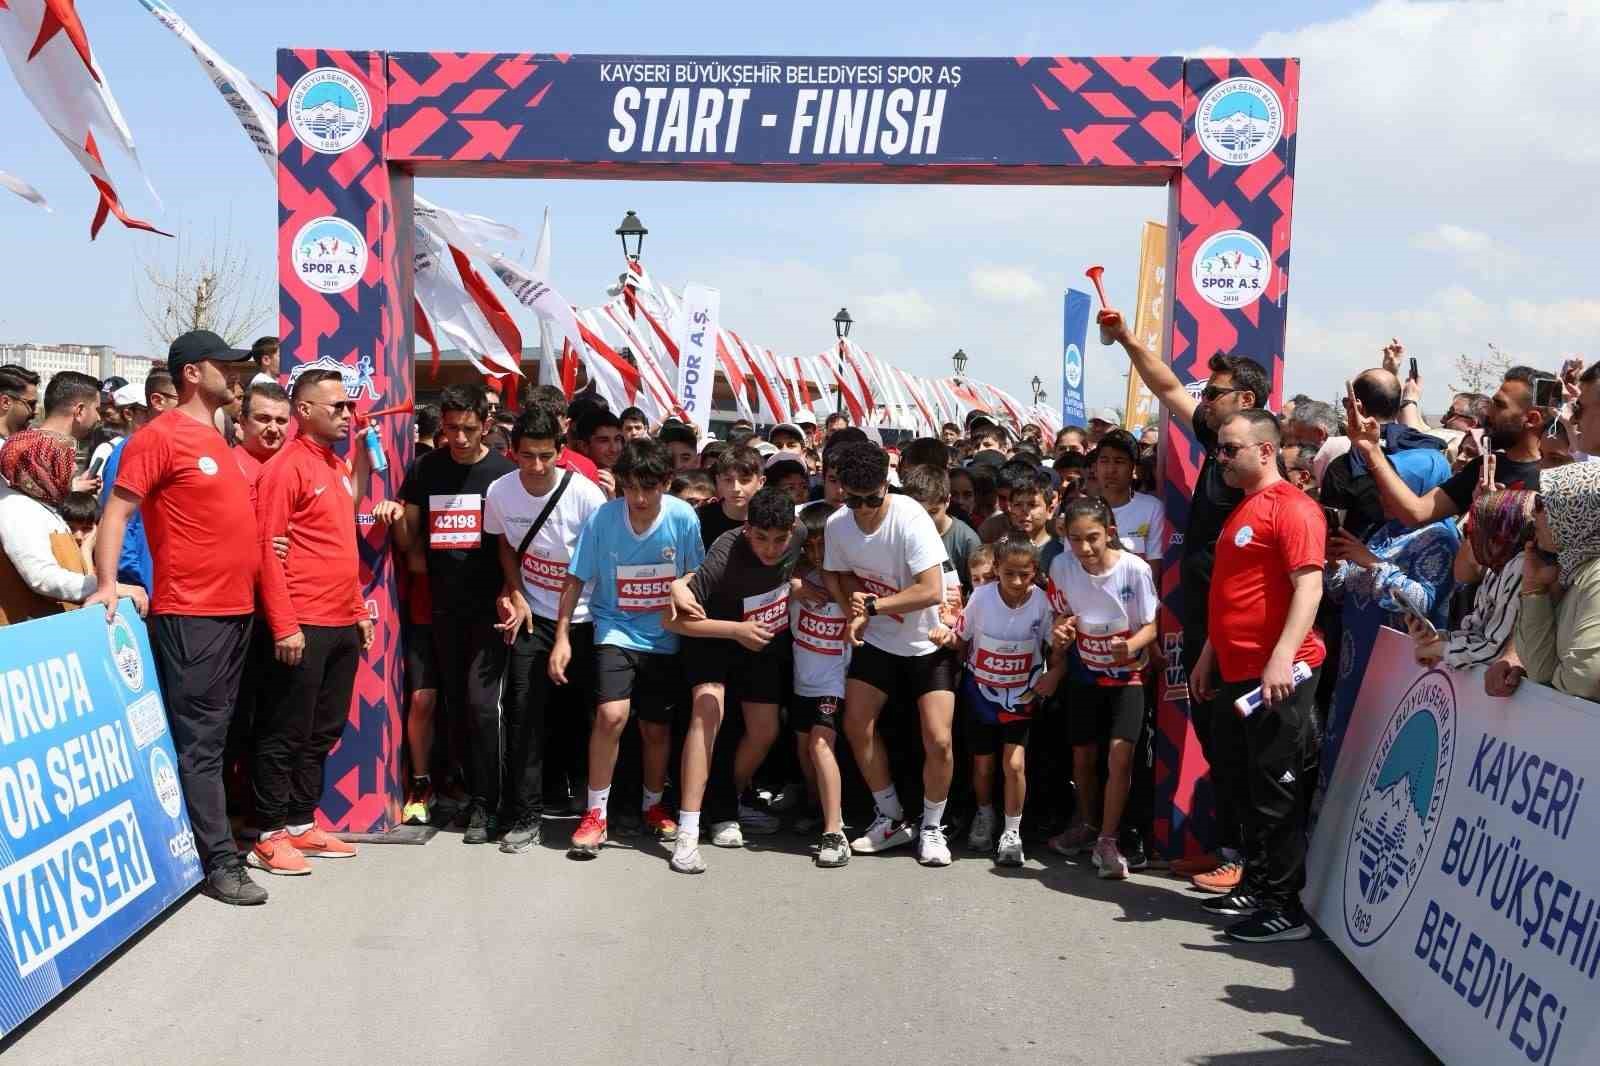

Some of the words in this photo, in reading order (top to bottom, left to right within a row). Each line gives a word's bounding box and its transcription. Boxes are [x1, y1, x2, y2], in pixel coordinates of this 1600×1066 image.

[887, 66, 933, 84] SPOR
[938, 66, 961, 88] AŞ
[608, 86, 751, 153] START
[789, 87, 947, 155] FINISH
[302, 263, 333, 273] SPOR
[1201, 278, 1234, 289] SPOR
[684, 354, 702, 412] SPOR
[434, 514, 477, 529] 42198
[525, 557, 567, 578] 43052
[800, 615, 845, 635] 43037
[1468, 733, 1585, 840] KAYSERİ
[3, 812, 149, 966] KAYSERİ
[1351, 904, 1373, 934] 1869
